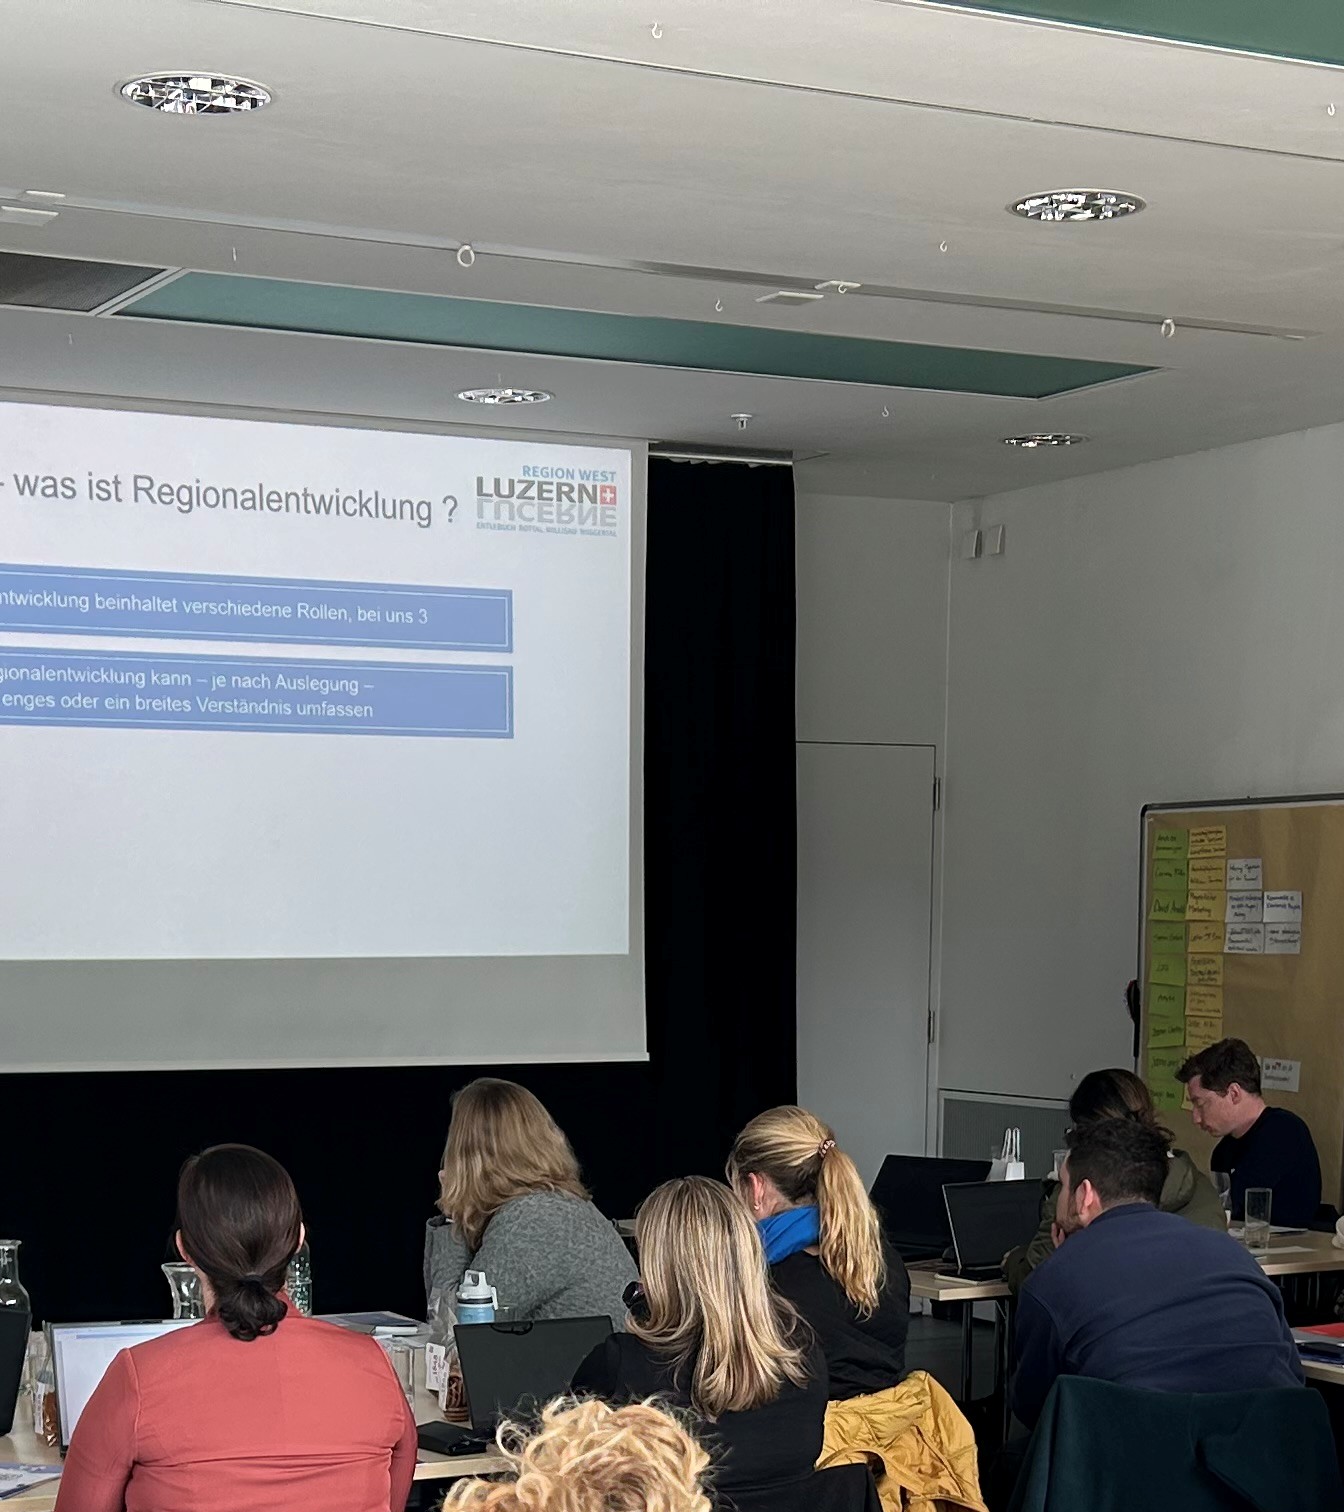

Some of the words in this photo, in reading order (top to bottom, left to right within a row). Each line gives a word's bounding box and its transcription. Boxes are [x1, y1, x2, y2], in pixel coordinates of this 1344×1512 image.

[522, 465, 574, 481] REGION
[578, 468, 617, 483] WEST
[12, 473, 77, 500] was
[87, 471, 123, 503] ist
[133, 475, 433, 528] Regionalentwicklung
[442, 494, 459, 524] ?
[476, 476, 598, 504] LUZERN
[94, 592, 178, 613] beinhaltet
[182, 599, 292, 619] verschiedene
[297, 602, 352, 623] Rollen,
[357, 605, 381, 622] bei
[385, 610, 414, 624] uns
[418, 608, 428, 625] 3
[151, 669, 192, 686] kann
[211, 670, 228, 692] je
[231, 673, 271, 690] nach
[274, 673, 359, 696] Auslegung
[1, 693, 56, 712] enges
[60, 692, 100, 709] oder
[104, 697, 130, 710] ein
[135, 694, 192, 712] breites
[195, 696, 292, 715] Verständnis
[296, 700, 373, 718] umfassen
